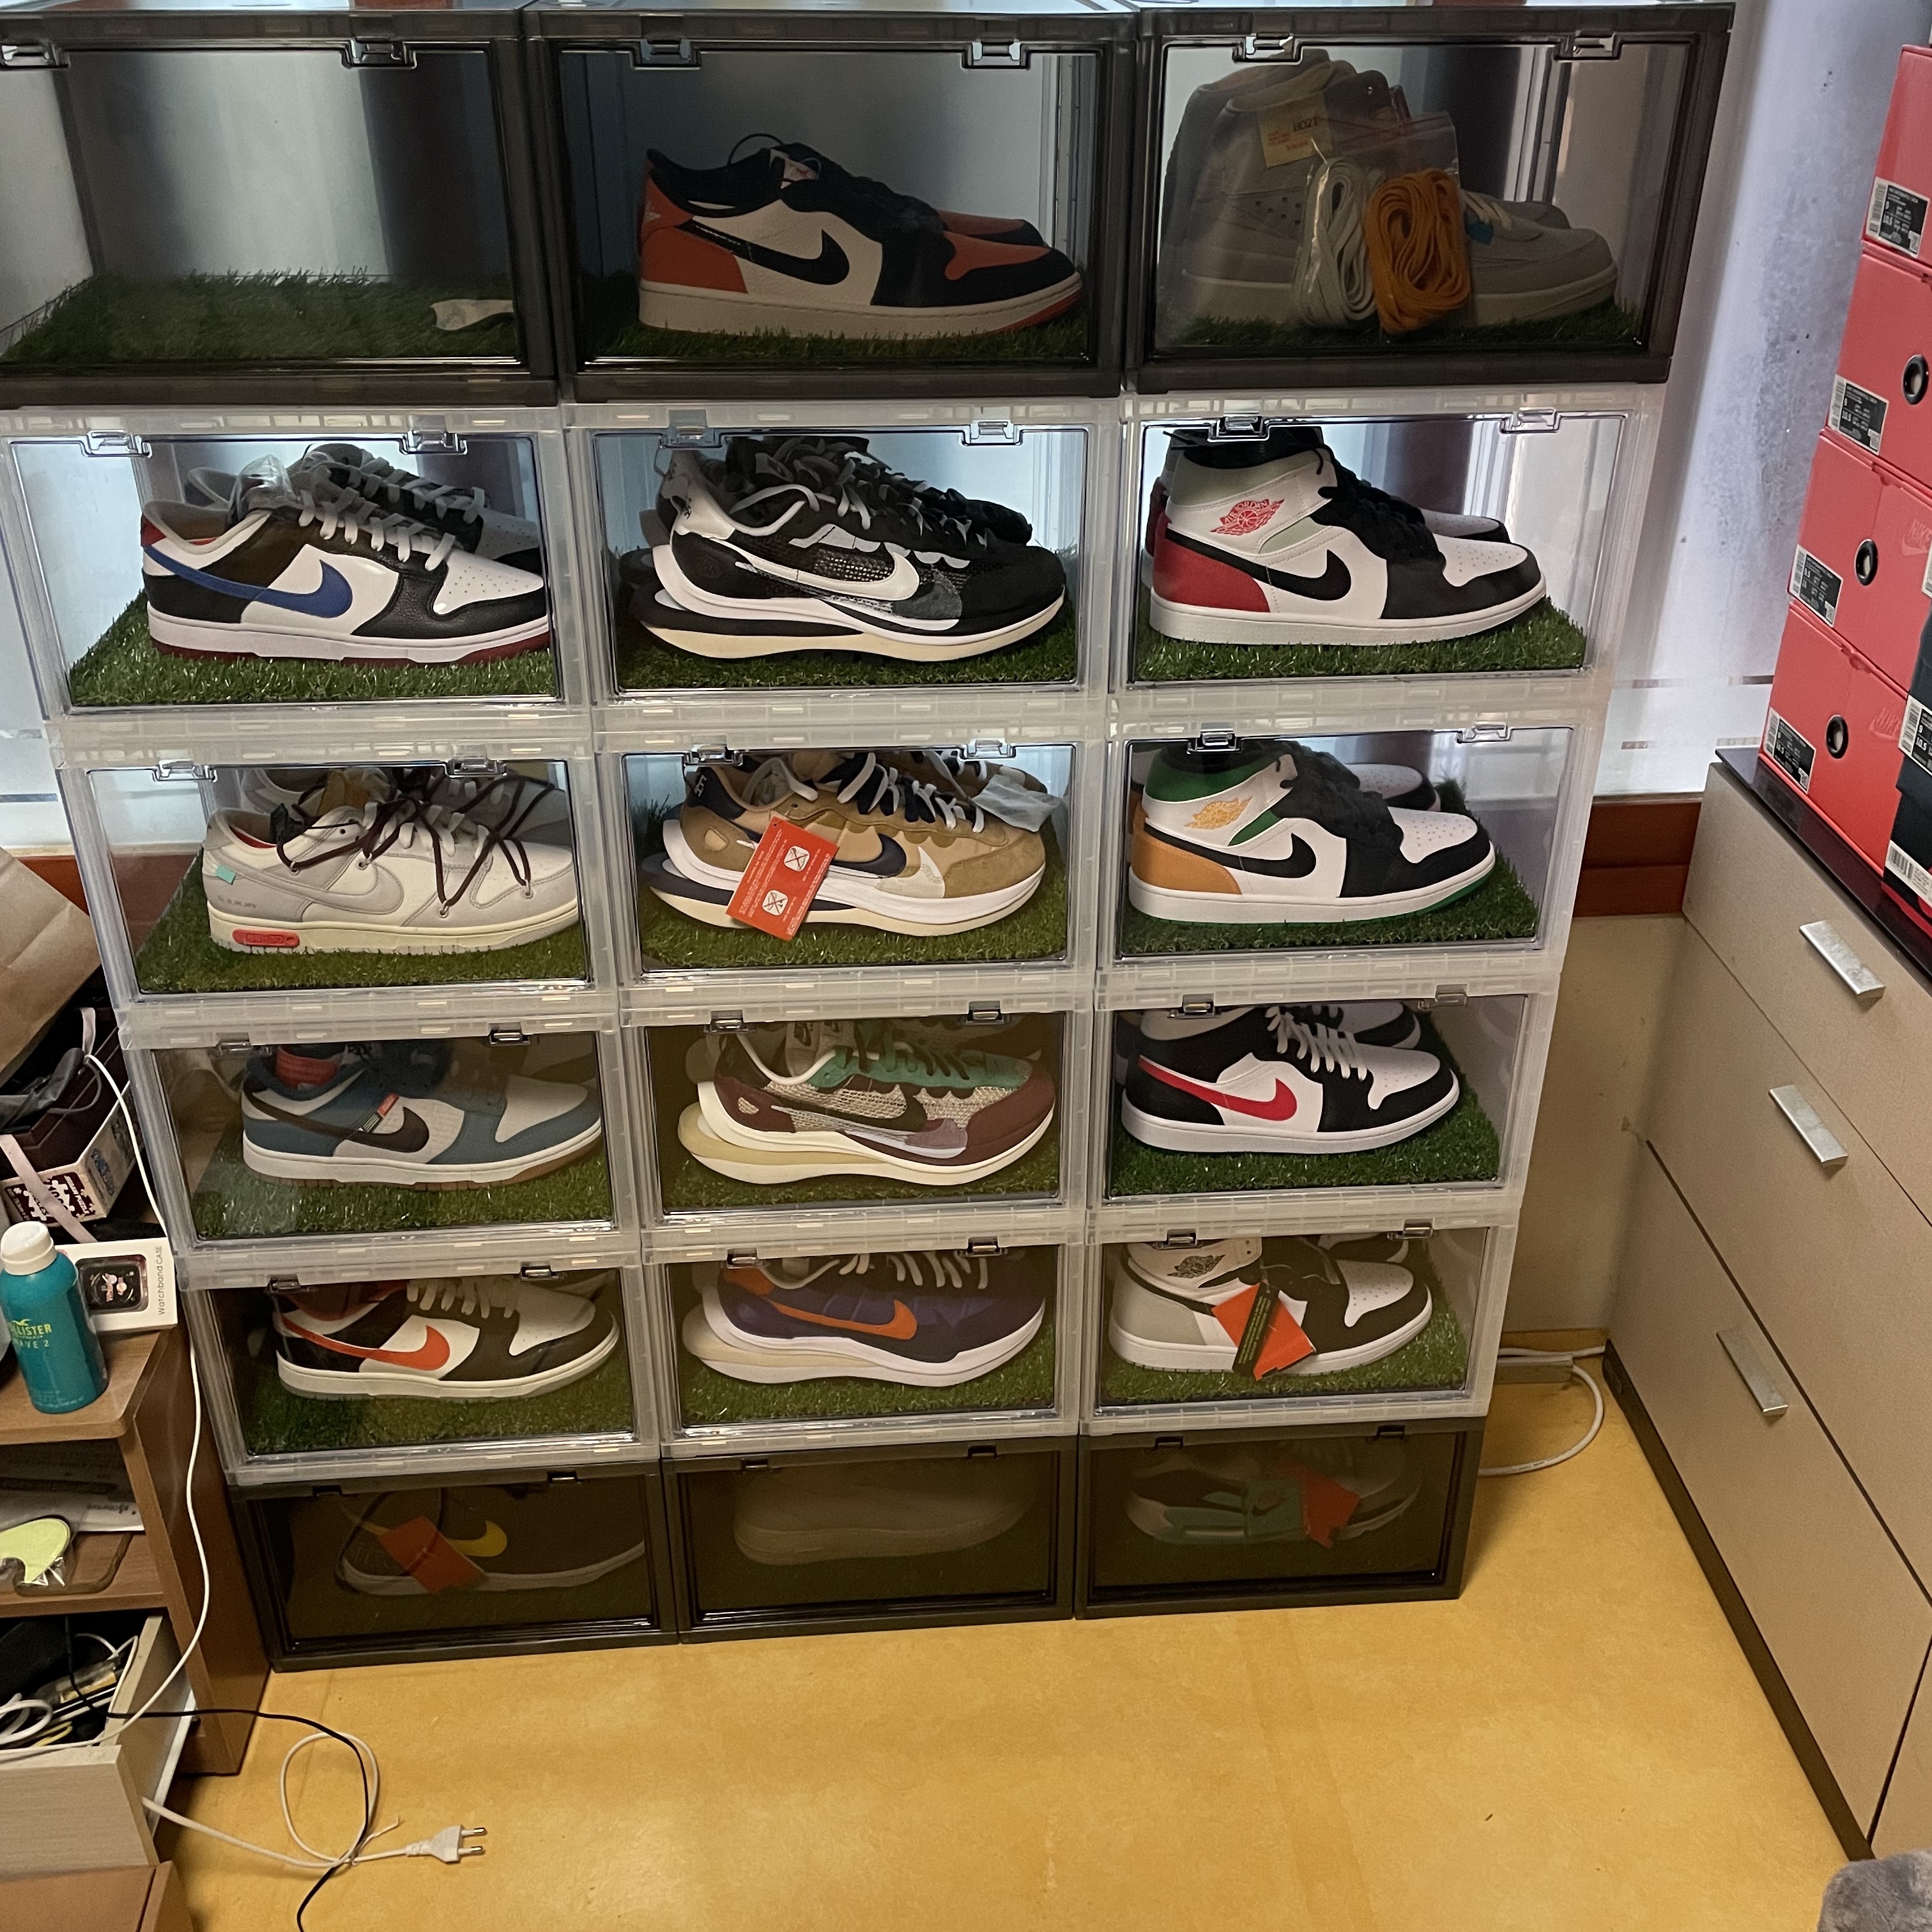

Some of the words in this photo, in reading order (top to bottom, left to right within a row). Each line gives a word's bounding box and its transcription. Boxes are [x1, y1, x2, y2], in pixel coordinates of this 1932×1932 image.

[1225, 511, 1236, 524] AIR
[1234, 500, 1268, 511] JORDAN
[157, 1266, 165, 1315] Watchband
[9, 1322, 52, 1336] LLISTER
[44, 1339, 50, 1347] 2
